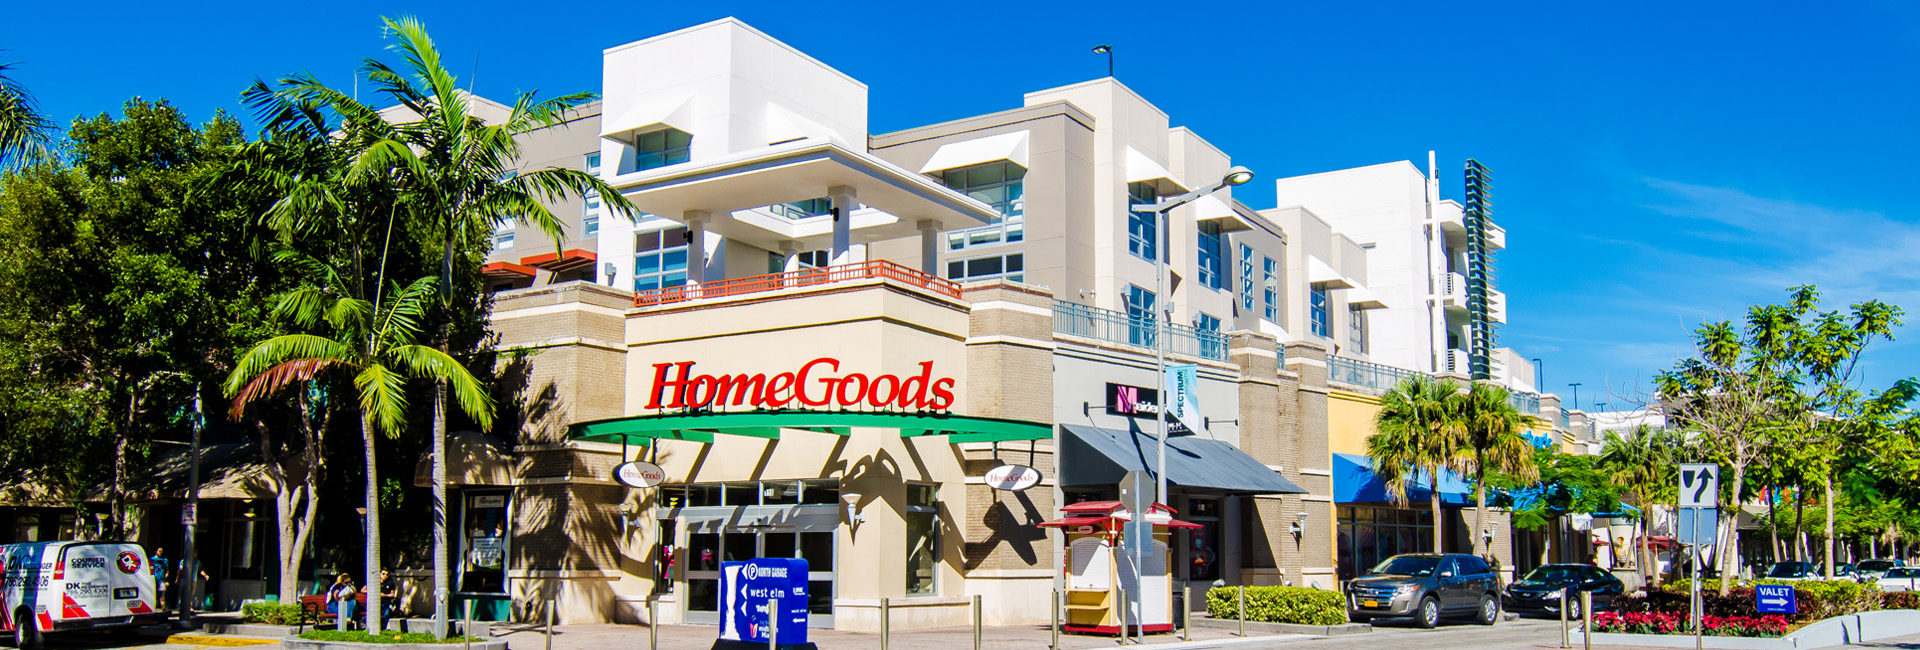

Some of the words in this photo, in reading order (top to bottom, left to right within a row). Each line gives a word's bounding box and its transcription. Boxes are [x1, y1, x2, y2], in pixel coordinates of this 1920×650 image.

[644, 357, 954, 410] HomeGoods
[624, 469, 661, 480] HomeGoods
[990, 473, 1034, 482] HomeGoods
[758, 567, 771, 578] NORTH
[772, 567, 788, 578] GARAGE
[750, 588, 768, 598] west
[770, 588, 785, 598] elm
[1759, 587, 1790, 597] VALET
